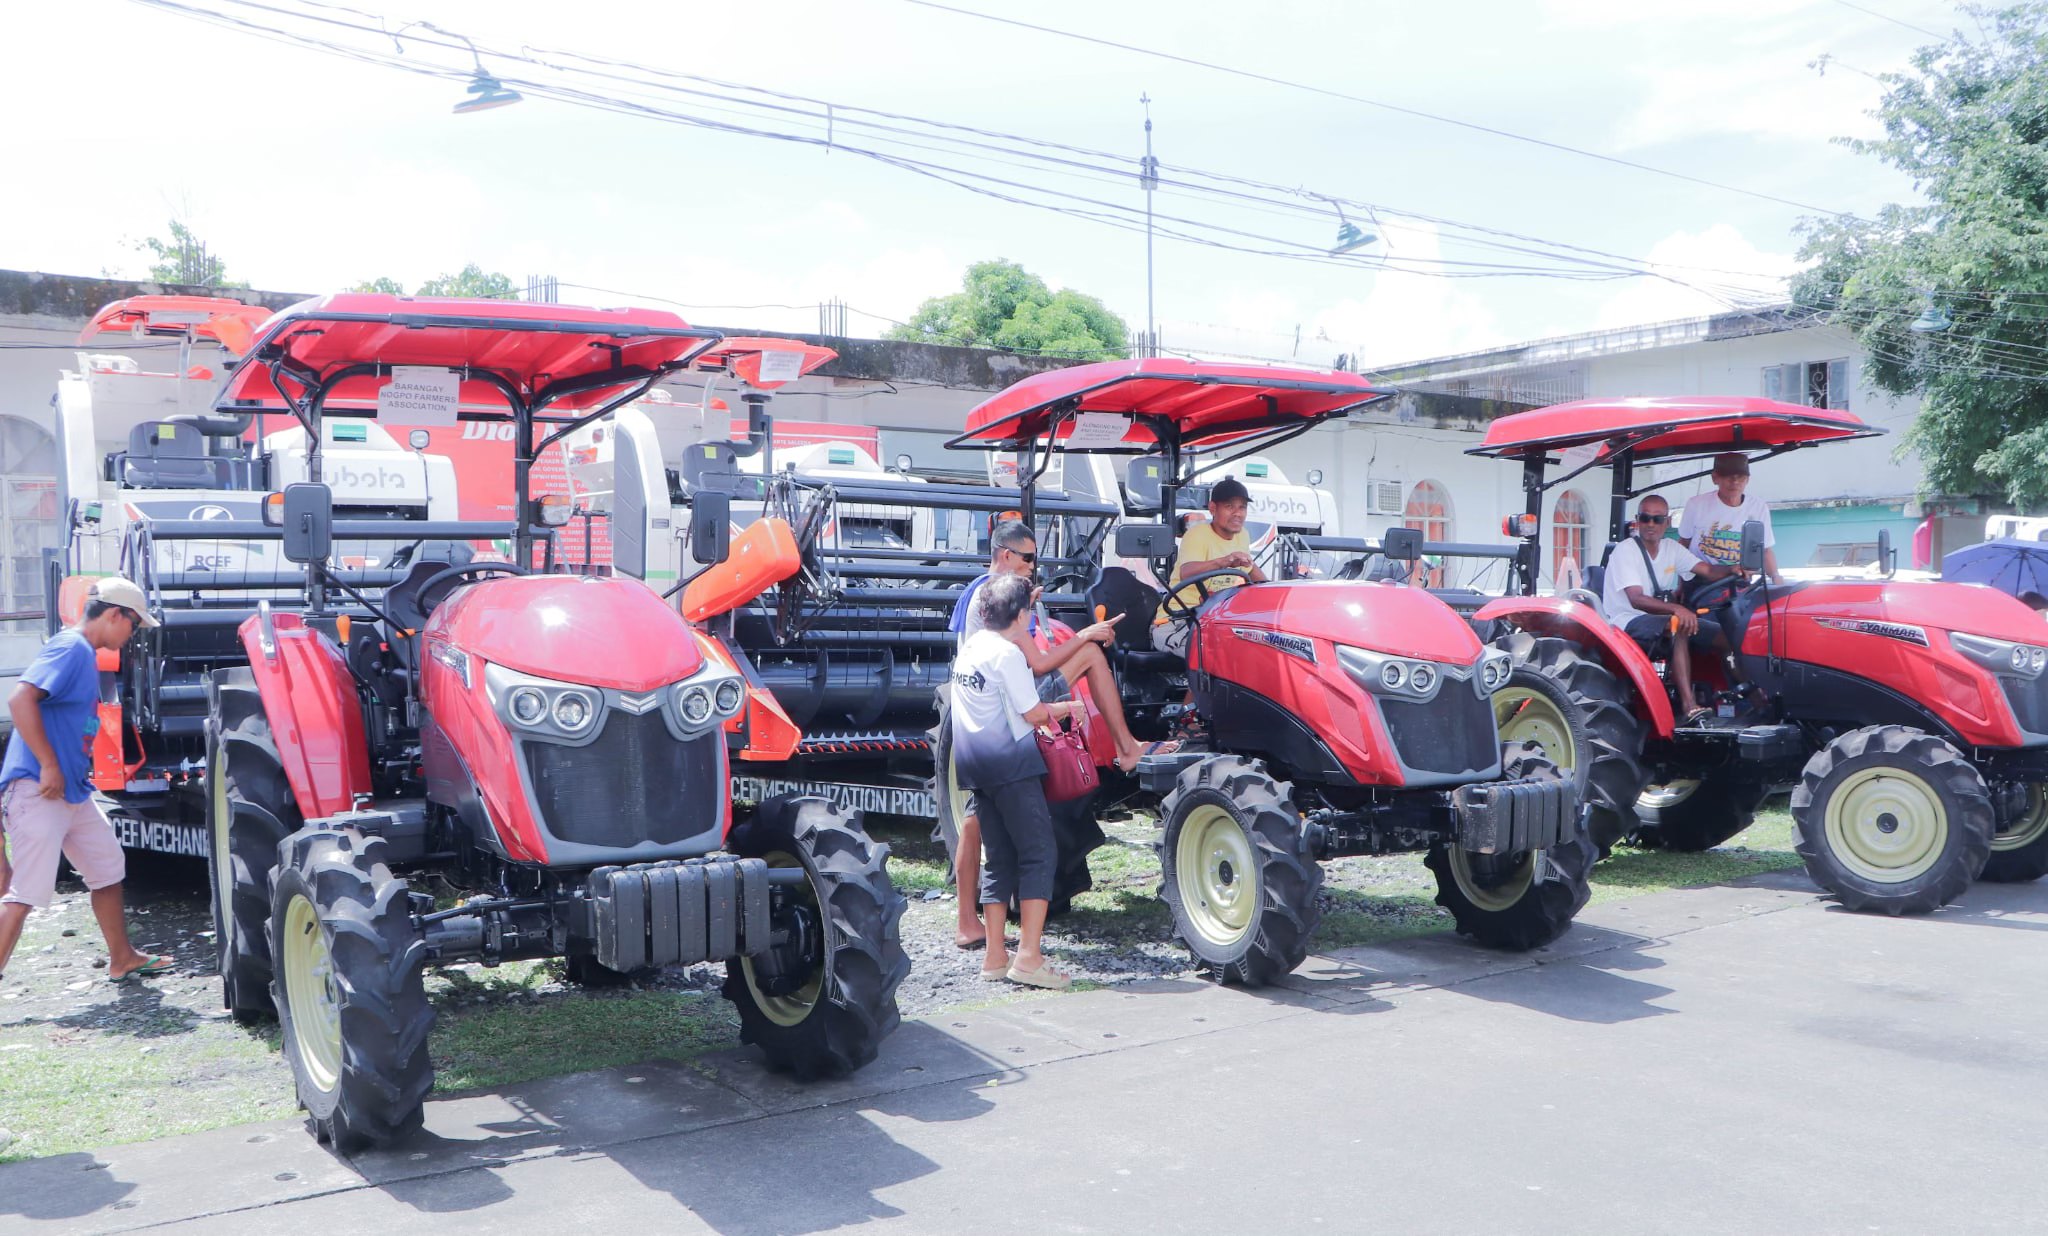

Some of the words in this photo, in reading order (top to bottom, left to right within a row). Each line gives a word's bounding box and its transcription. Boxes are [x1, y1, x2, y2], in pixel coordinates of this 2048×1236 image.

[394, 382, 445, 393] BARANGAY
[381, 391, 412, 400] NOGPO
[414, 393, 456, 403] FARMERS
[387, 401, 447, 412] ASSOCIATION
[193, 555, 232, 569] RCEF
[1866, 622, 1917, 638] YANMAR
[1268, 634, 1307, 652] YANMAR
[731, 776, 758, 801] CEF
[892, 790, 937, 818] PROG
[110, 817, 139, 848] CEF
[141, 820, 209, 858] MECHANI
